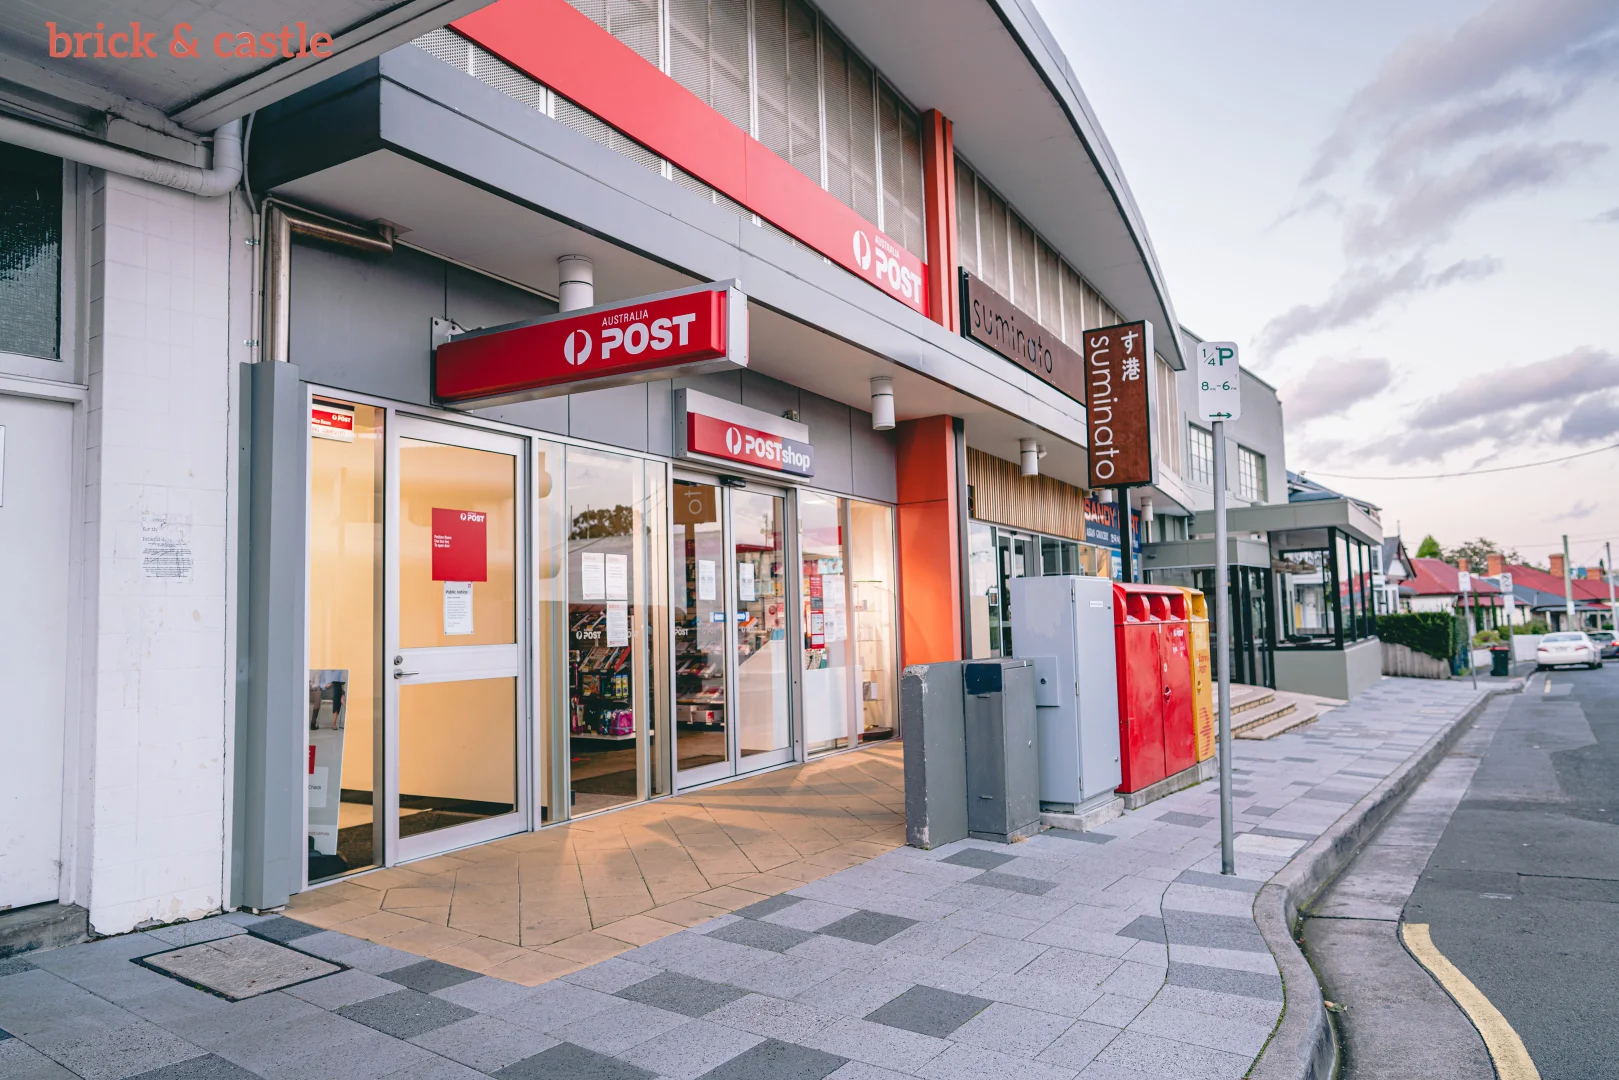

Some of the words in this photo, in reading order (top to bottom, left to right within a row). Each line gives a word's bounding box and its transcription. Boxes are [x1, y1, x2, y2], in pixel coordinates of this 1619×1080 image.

[875, 234, 900, 259] AUSTRALIA
[875, 247, 922, 304] POST
[601, 313, 696, 360] POST
[602, 309, 649, 326] AUSTRALIA
[974, 299, 1053, 374] suminato
[1090, 335, 1120, 480] suminato
[467, 514, 485, 522] POST
[1084, 498, 1116, 528] SANDY
